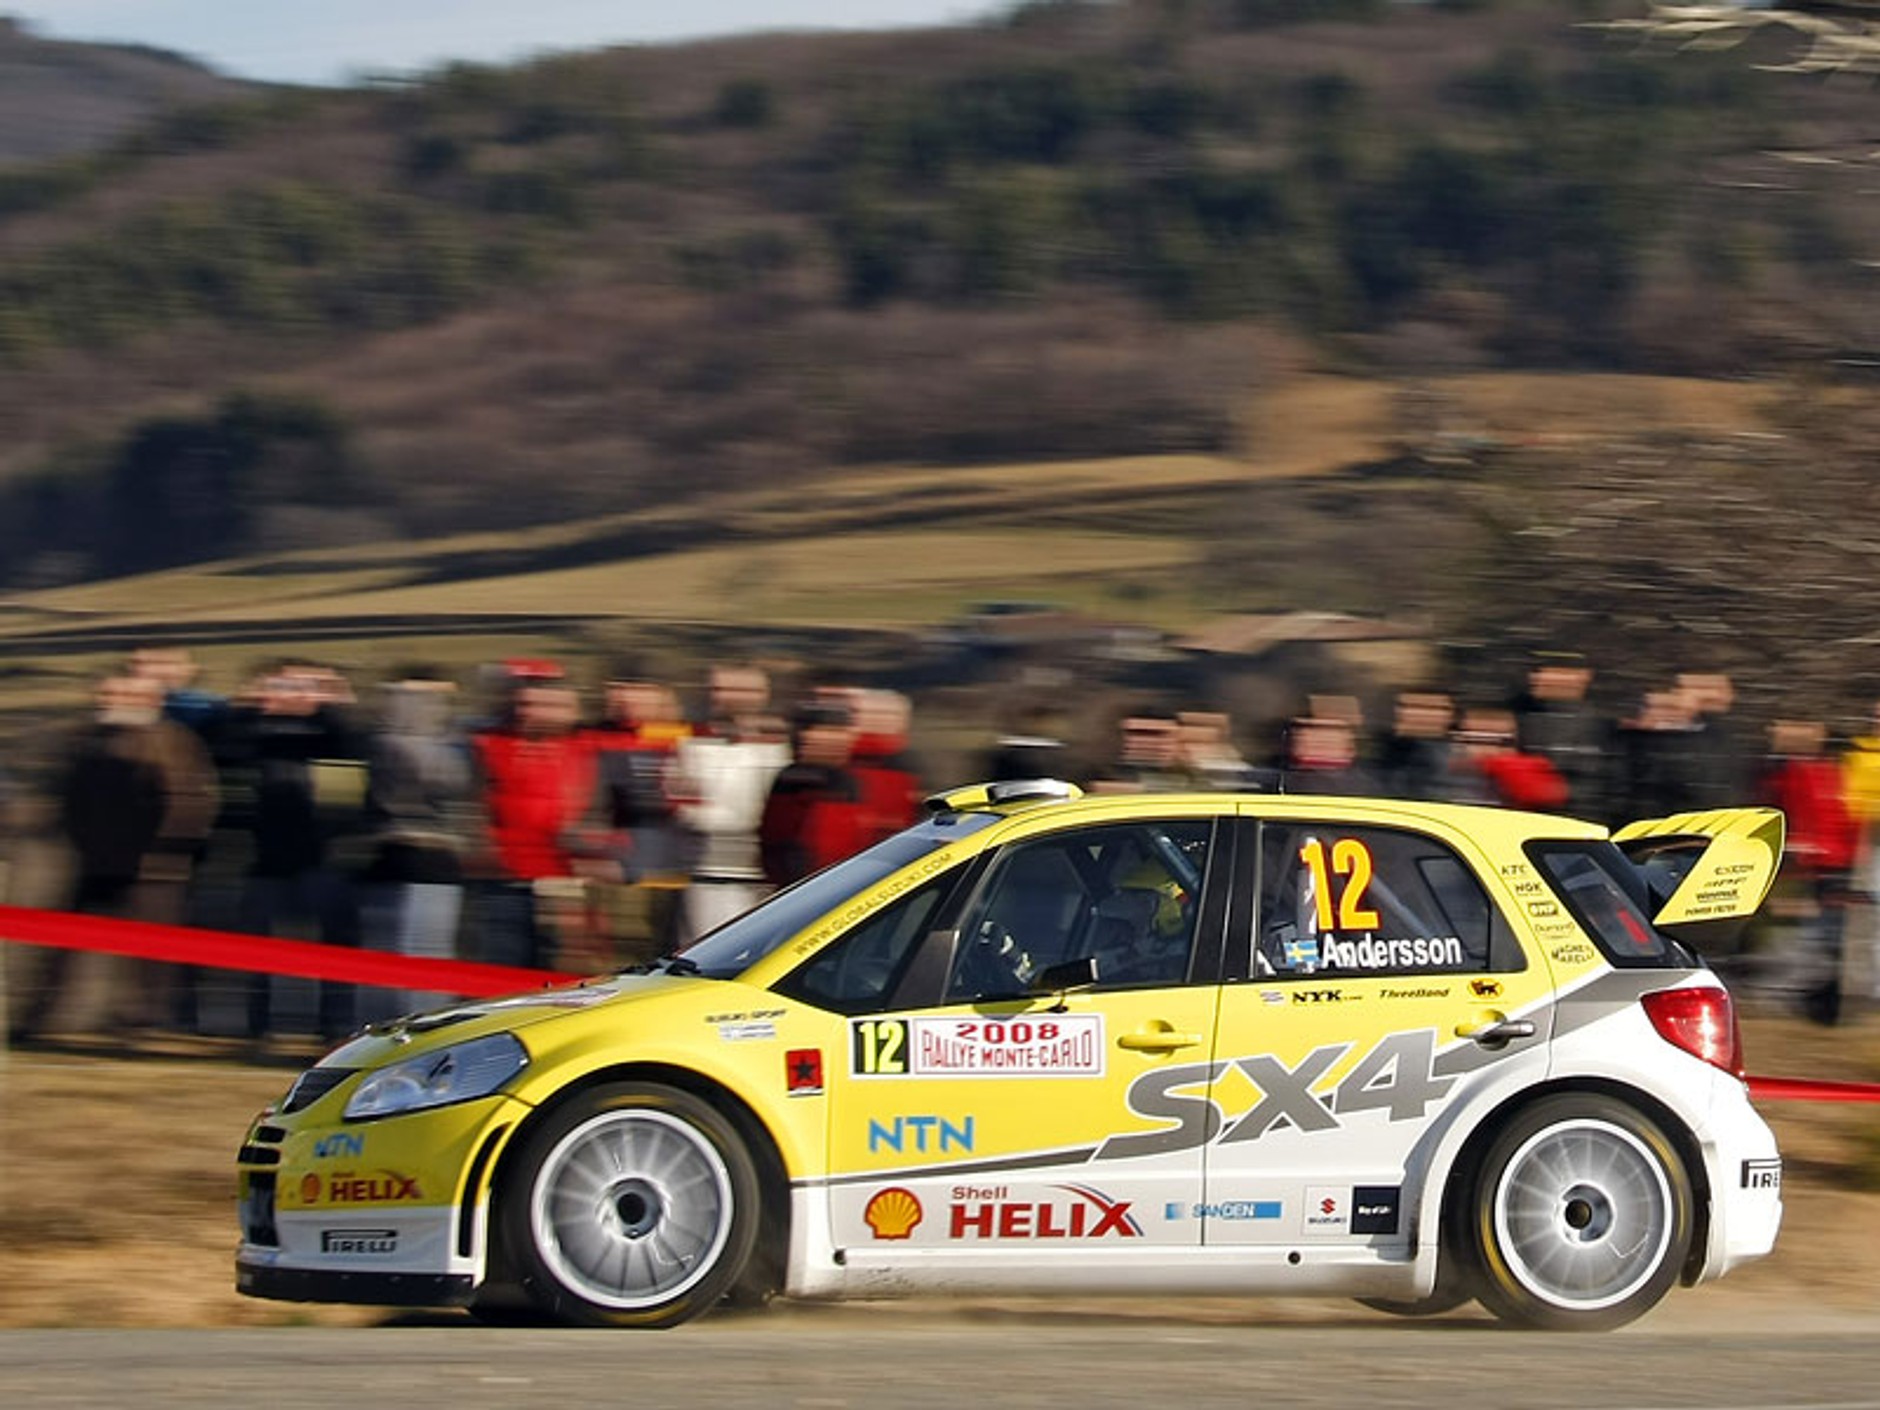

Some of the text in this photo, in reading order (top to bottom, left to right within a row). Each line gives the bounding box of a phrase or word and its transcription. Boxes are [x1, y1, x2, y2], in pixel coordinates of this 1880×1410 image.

[1300, 838, 1381, 931] 12
[1321, 931, 1463, 969] Andersson
[1293, 990, 1343, 1003] NYK
[859, 1021, 905, 1074] 12
[922, 1028, 1093, 1068] RALLYE MONTE-CARLO
[957, 1023, 1060, 1045] 2008
[1093, 1028, 1458, 1160] SX4
[313, 1132, 365, 1158] NTN
[868, 1115, 975, 1153] NTN
[329, 1179, 423, 1201] HELIX
[952, 1185, 1008, 1200] Shell
[949, 1202, 1137, 1239] HELIX
[321, 1229, 398, 1253] PIRELLI
